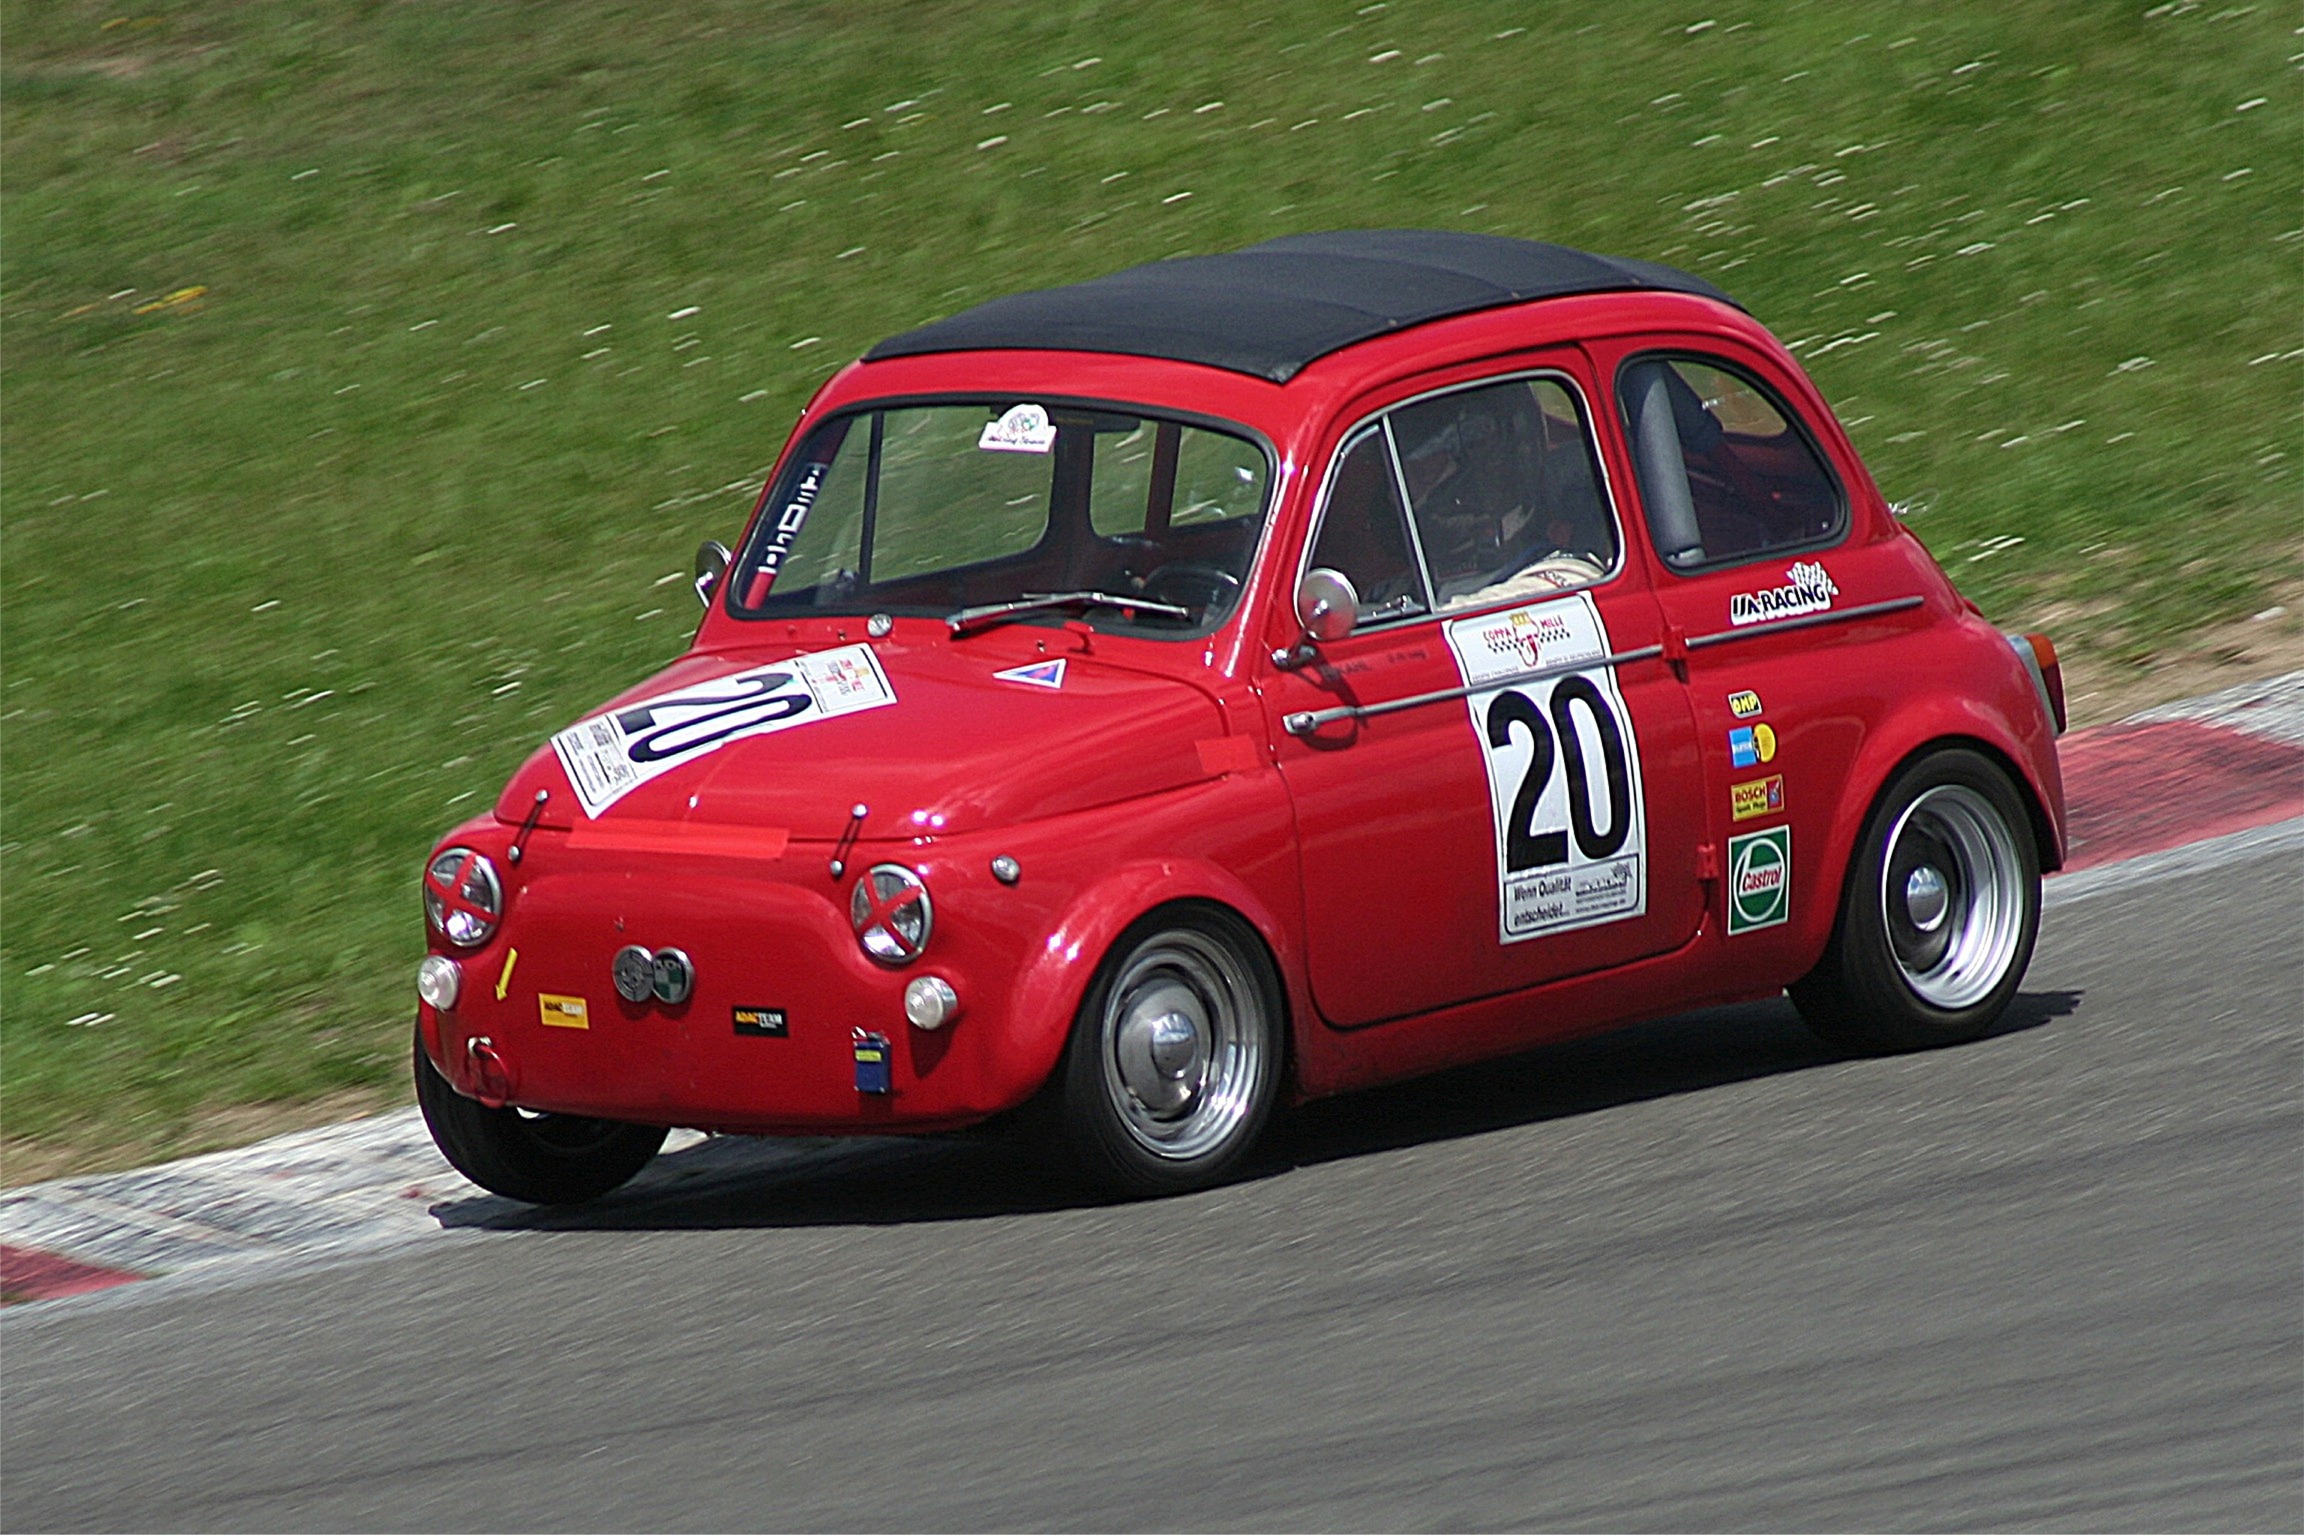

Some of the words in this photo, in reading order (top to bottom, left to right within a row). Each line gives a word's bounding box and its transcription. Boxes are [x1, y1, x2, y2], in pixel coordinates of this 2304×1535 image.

[1732, 694, 1757, 713] OMP
[616, 673, 812, 763] 20
[1486, 671, 1632, 874] 20
[1735, 785, 1766, 802] BOSCH
[1742, 865, 1782, 892] Castrol
